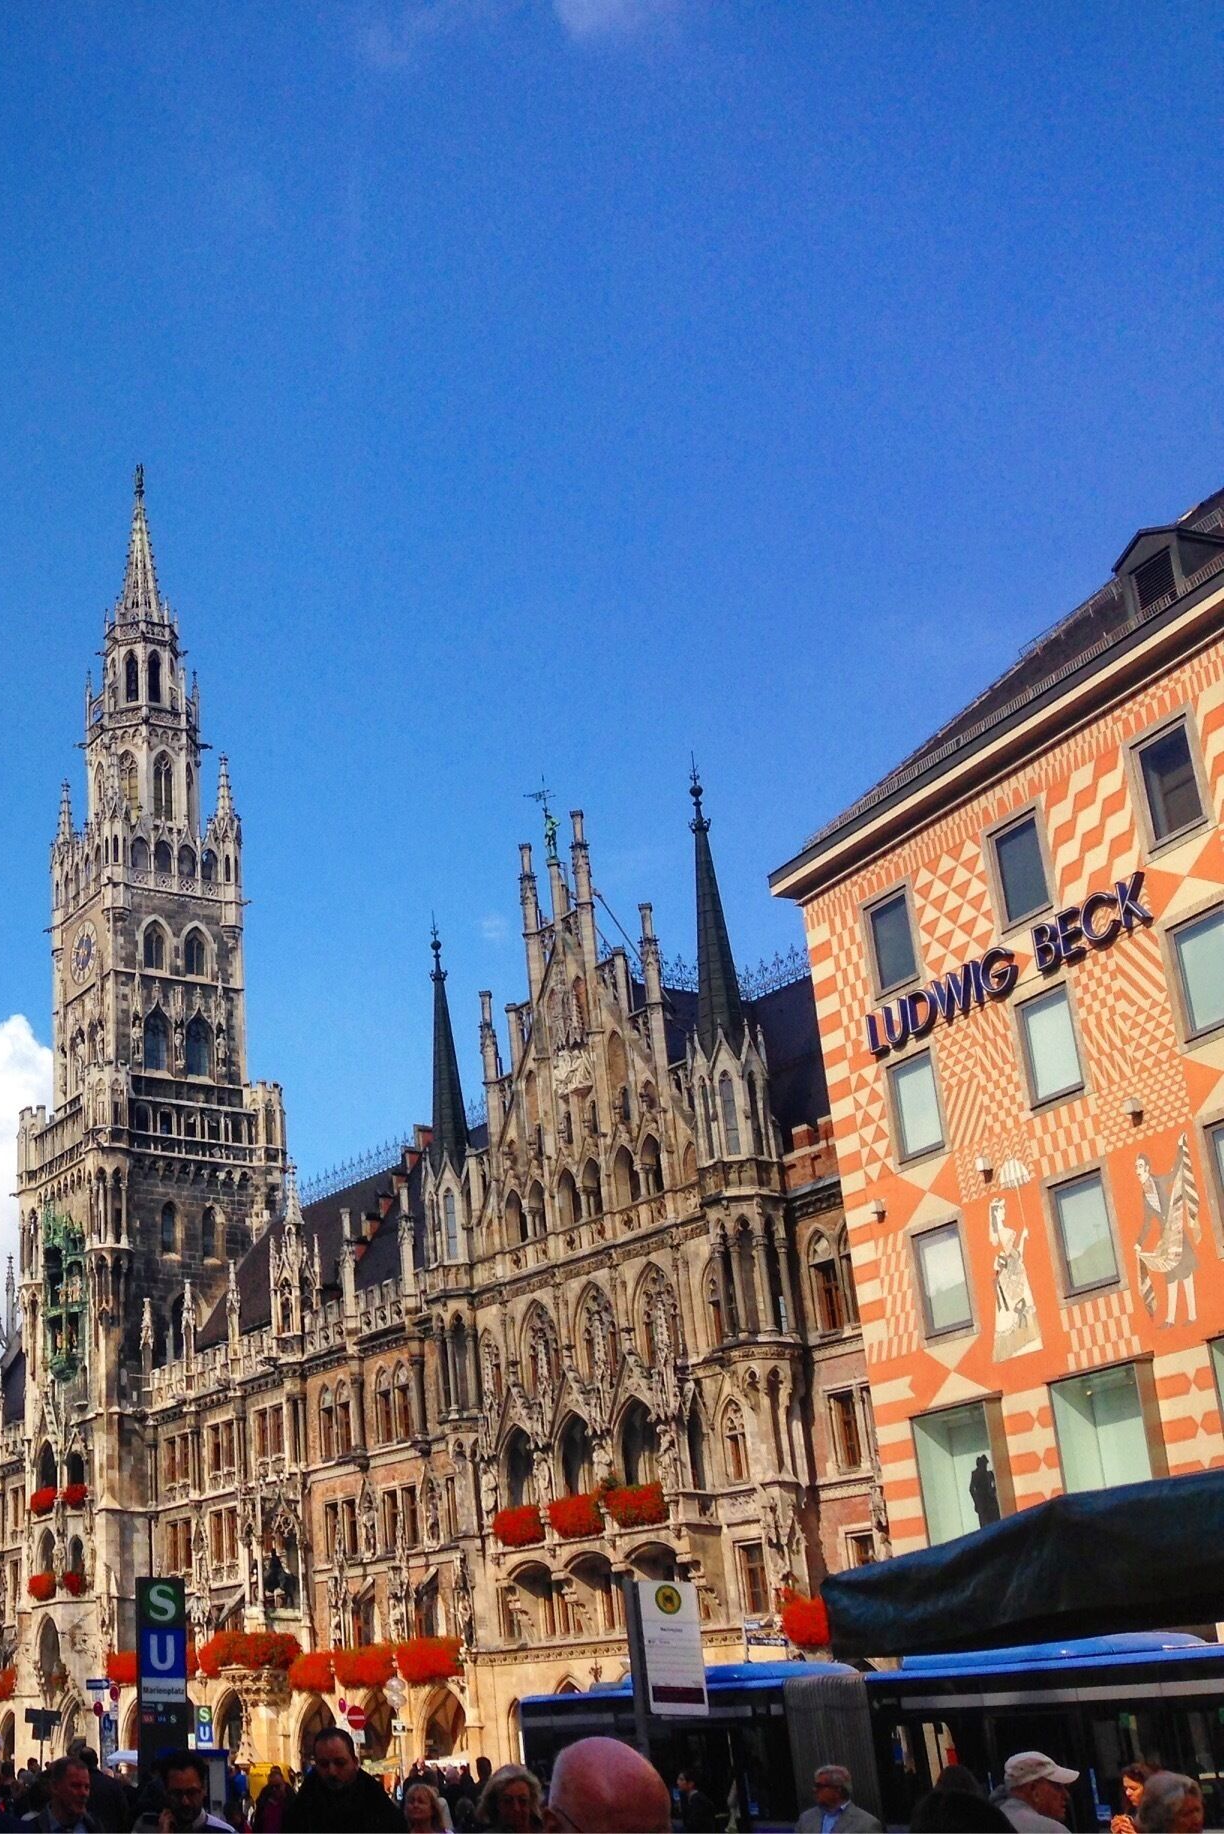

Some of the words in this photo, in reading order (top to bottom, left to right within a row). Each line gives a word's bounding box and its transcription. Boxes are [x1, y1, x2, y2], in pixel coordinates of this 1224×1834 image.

[865, 946, 1019, 1055] LUDWIG
[1030, 870, 1155, 972] BECK
[149, 1584, 176, 1622] S
[149, 1633, 175, 1671] U
[142, 1685, 185, 1696] Marienplatz
[199, 1707, 210, 1722] S
[199, 1726, 210, 1741] U
